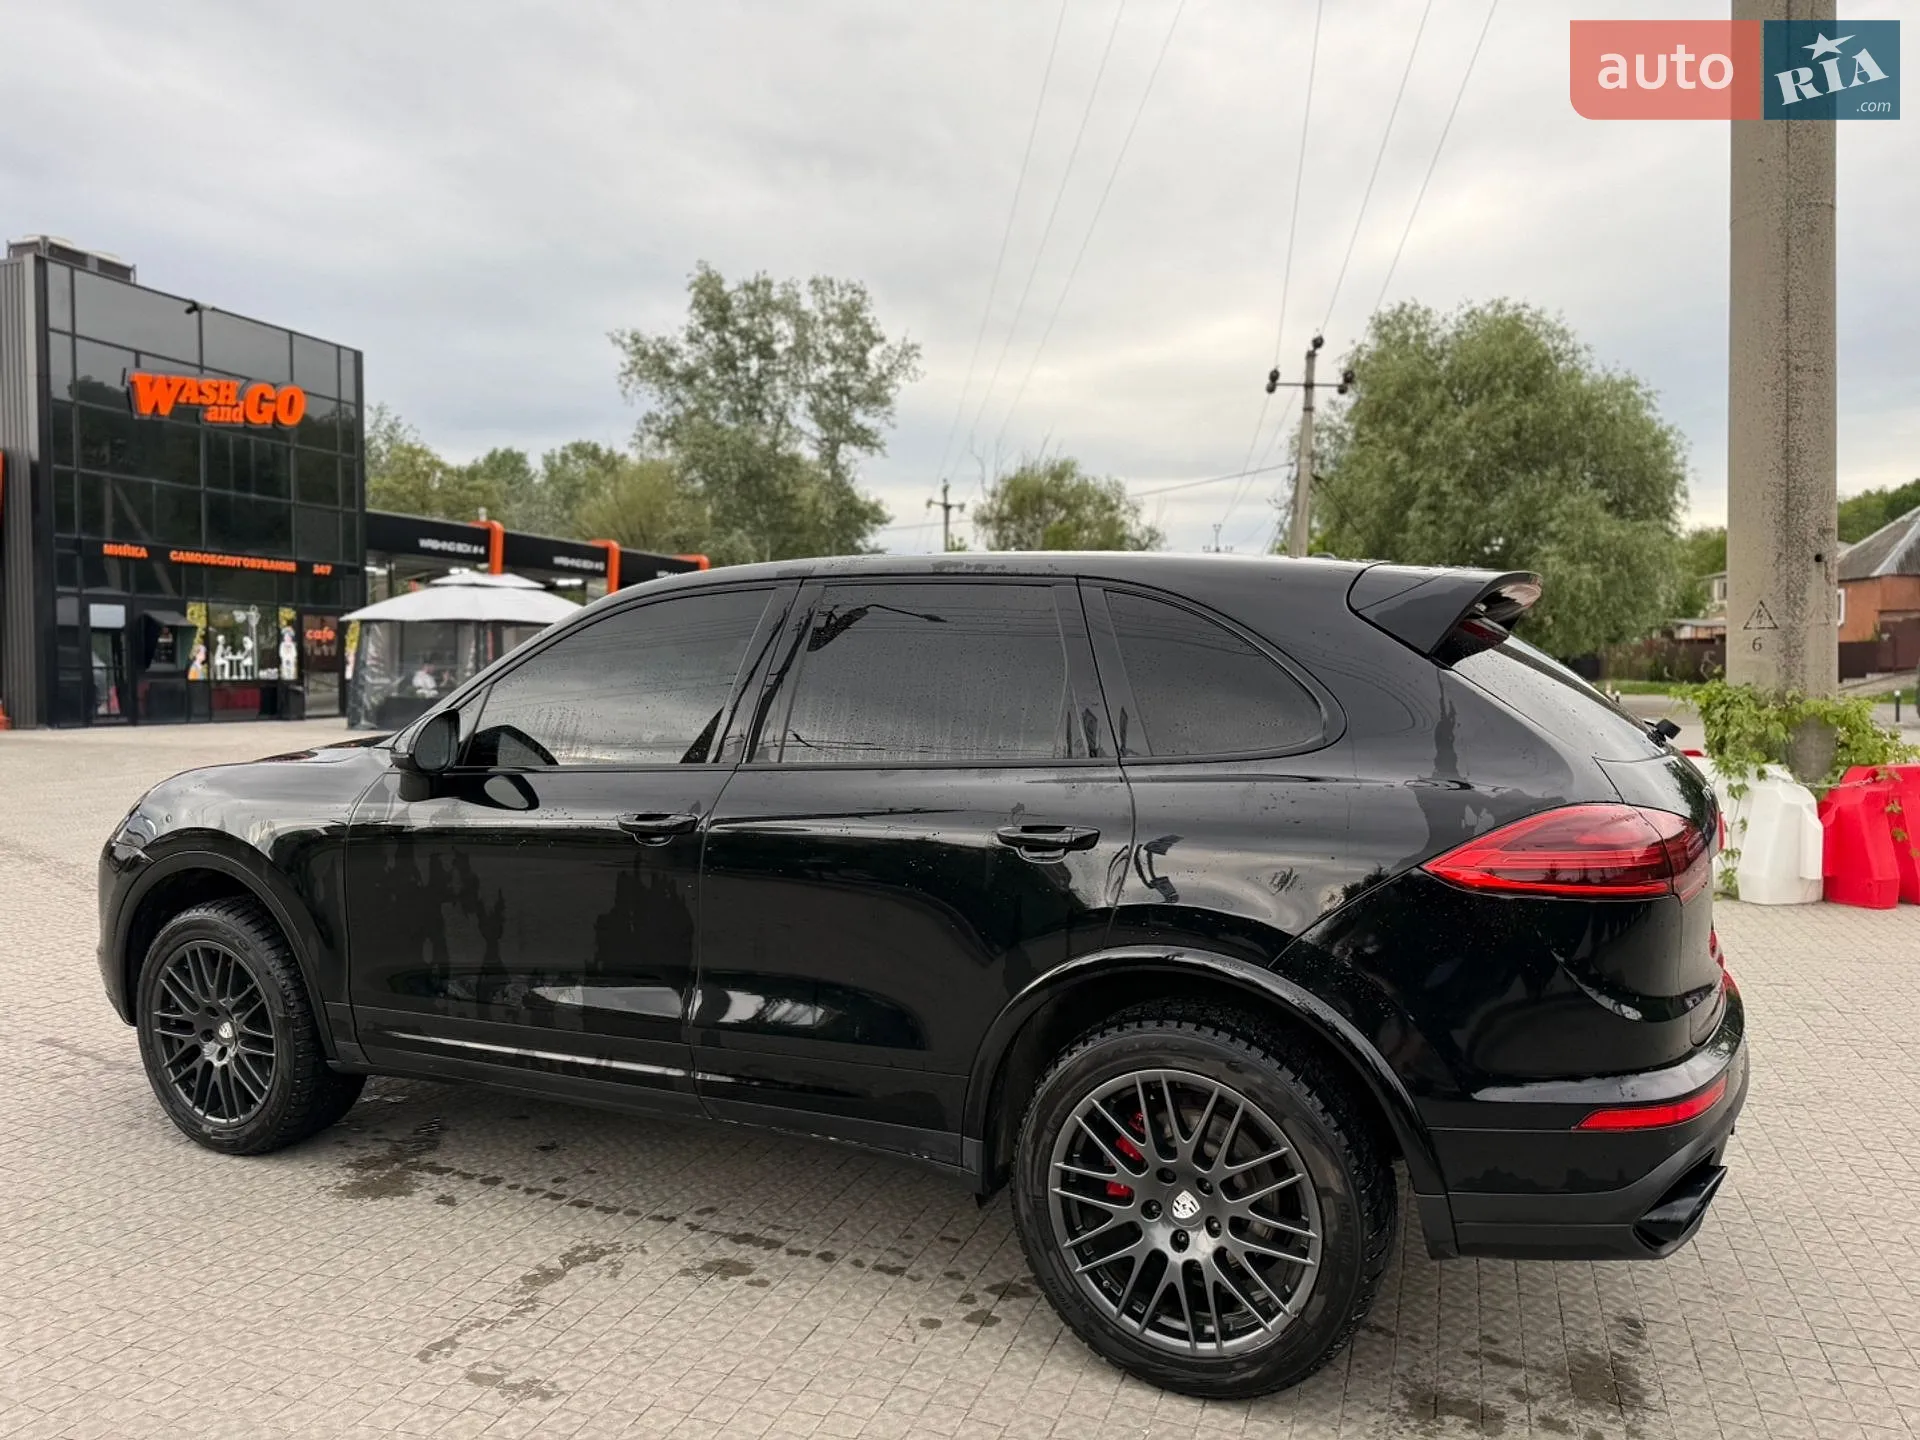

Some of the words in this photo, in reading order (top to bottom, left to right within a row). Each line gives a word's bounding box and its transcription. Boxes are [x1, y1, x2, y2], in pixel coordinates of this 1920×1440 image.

[129, 372, 239, 417] WASH
[204, 401, 245, 424] and
[245, 383, 307, 427] GO
[1752, 637, 1763, 652] 6
